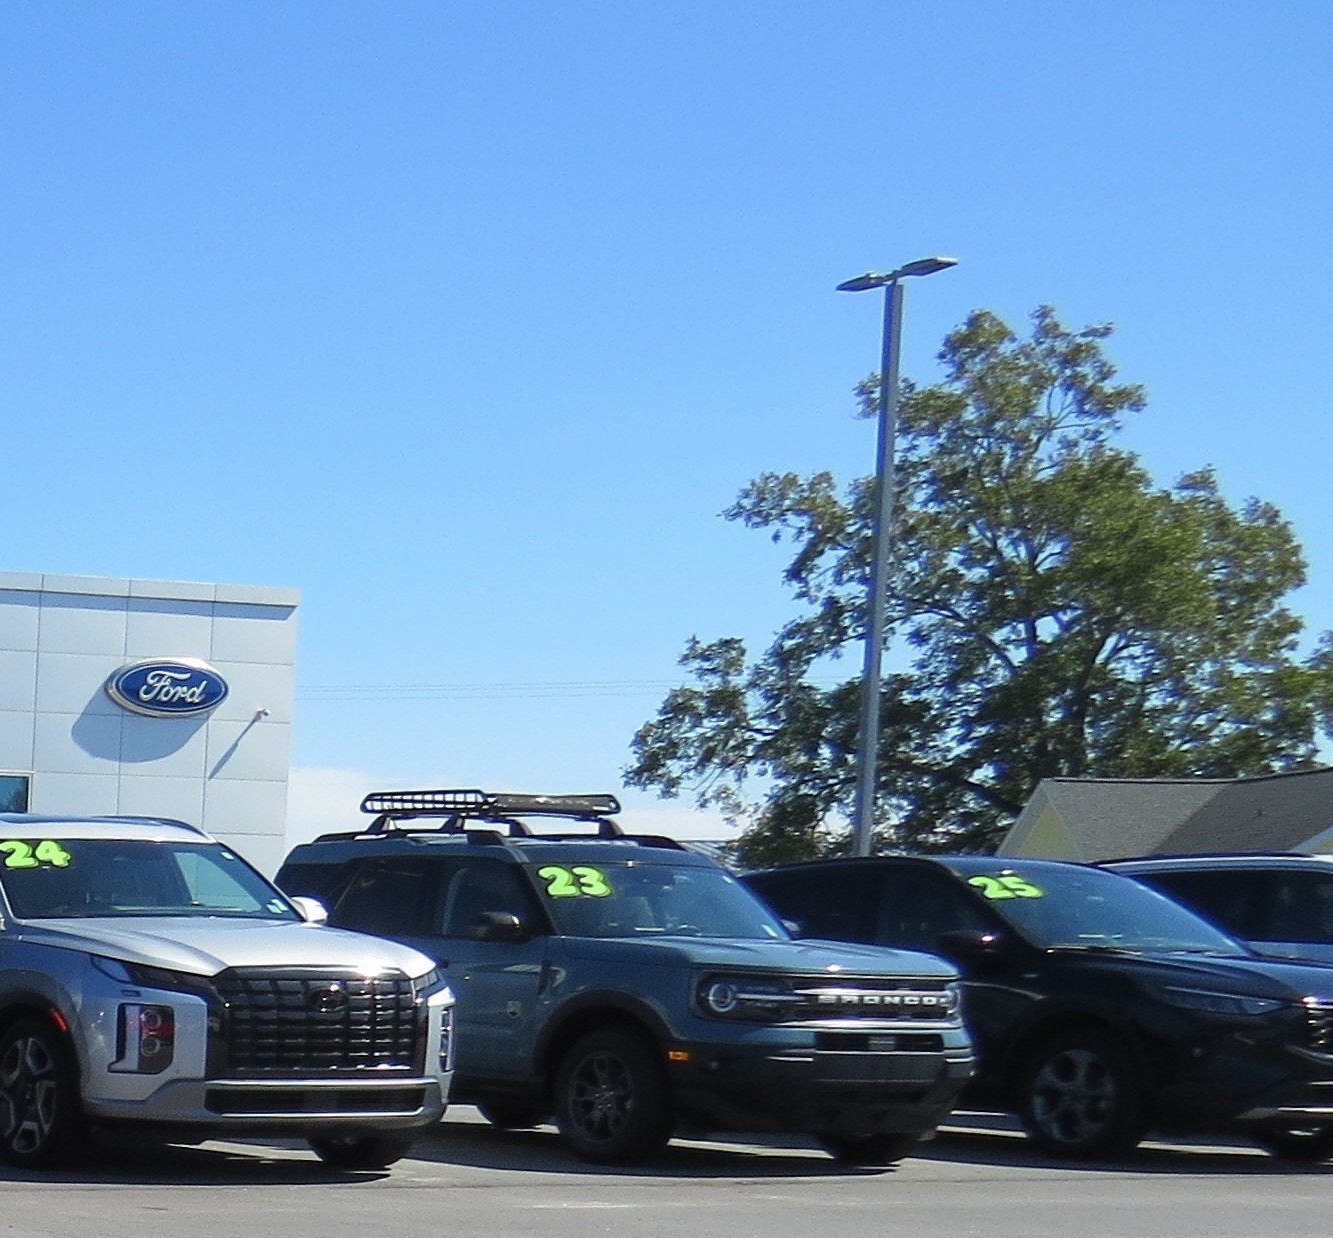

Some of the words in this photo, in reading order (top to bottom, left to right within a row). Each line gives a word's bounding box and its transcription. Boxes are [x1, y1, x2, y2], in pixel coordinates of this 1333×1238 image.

[138, 670, 208, 704] Ford
[538, 866, 611, 897] 23
[967, 875, 1044, 899] 25
[818, 994, 938, 1006] BRONCO
